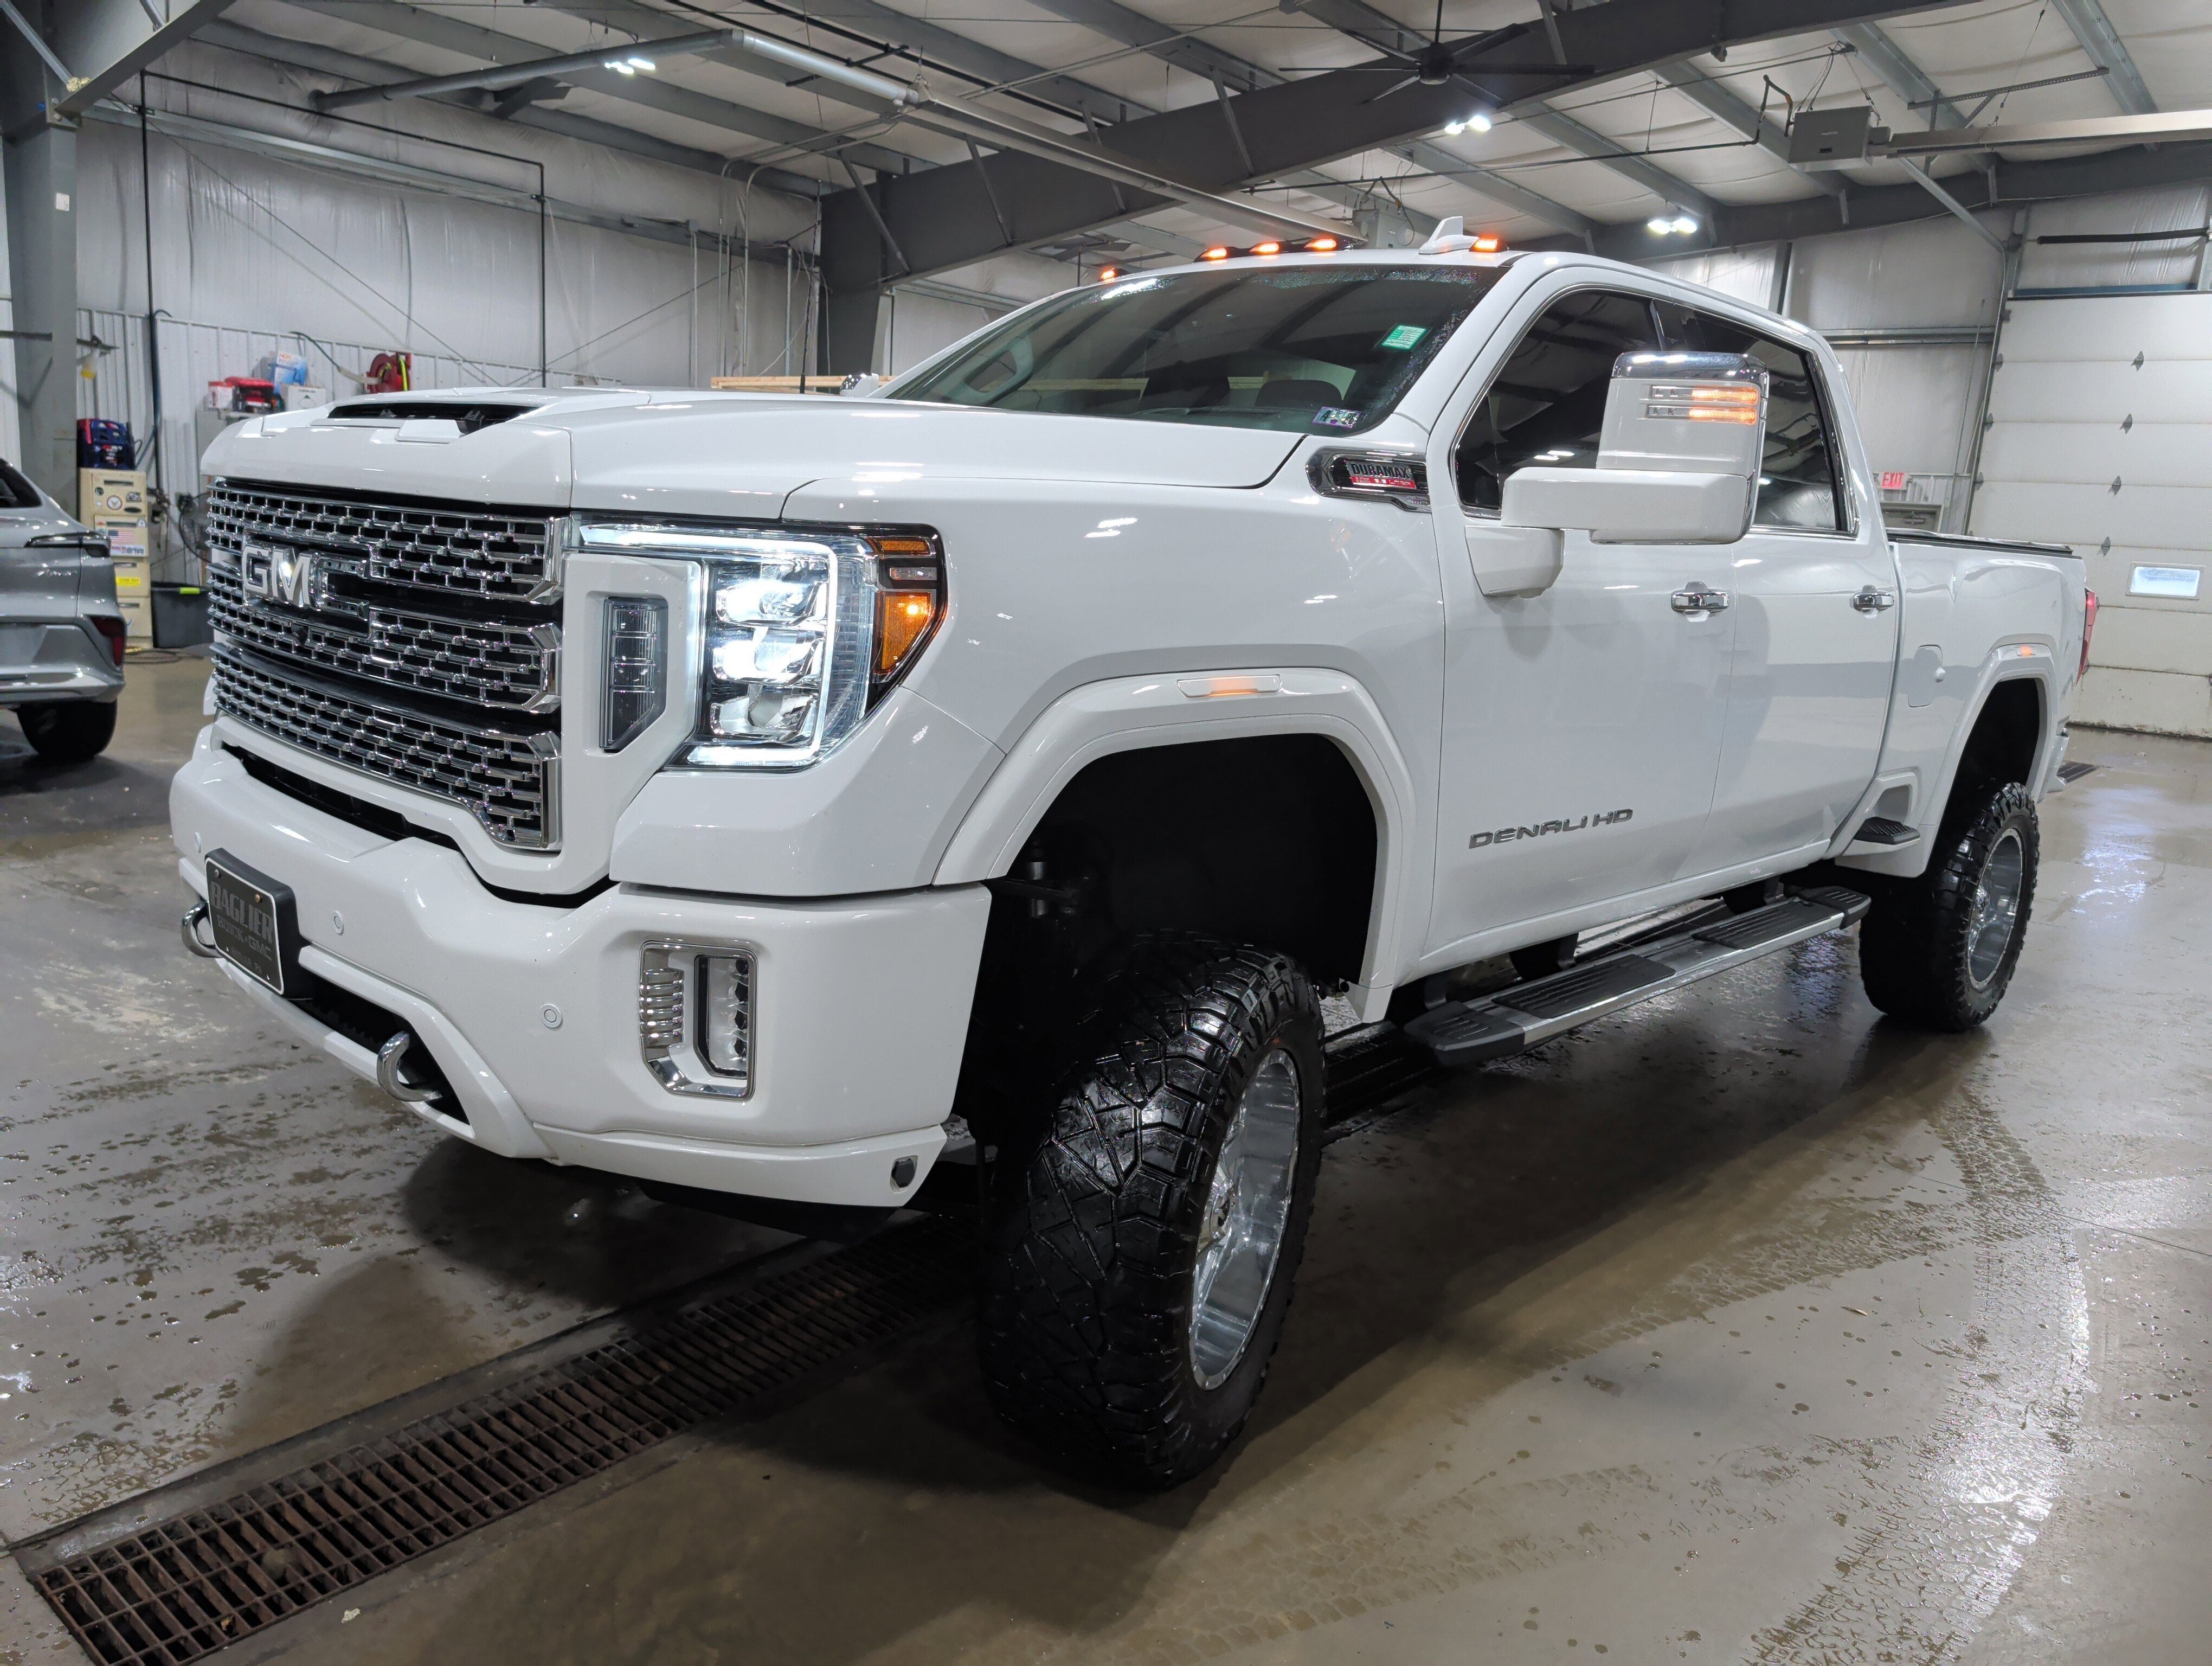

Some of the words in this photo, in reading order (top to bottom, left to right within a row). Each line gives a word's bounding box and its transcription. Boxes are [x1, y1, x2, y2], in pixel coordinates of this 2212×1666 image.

[1351, 463, 1411, 479] DURAMAX
[1882, 472, 1904, 488] EXIT
[242, 544, 370, 620] GMC
[1468, 815, 1588, 850] DENALI
[1592, 808, 1634, 828] HD
[211, 881, 273, 944] BAGLIER
[247, 934, 273, 962] GMC
